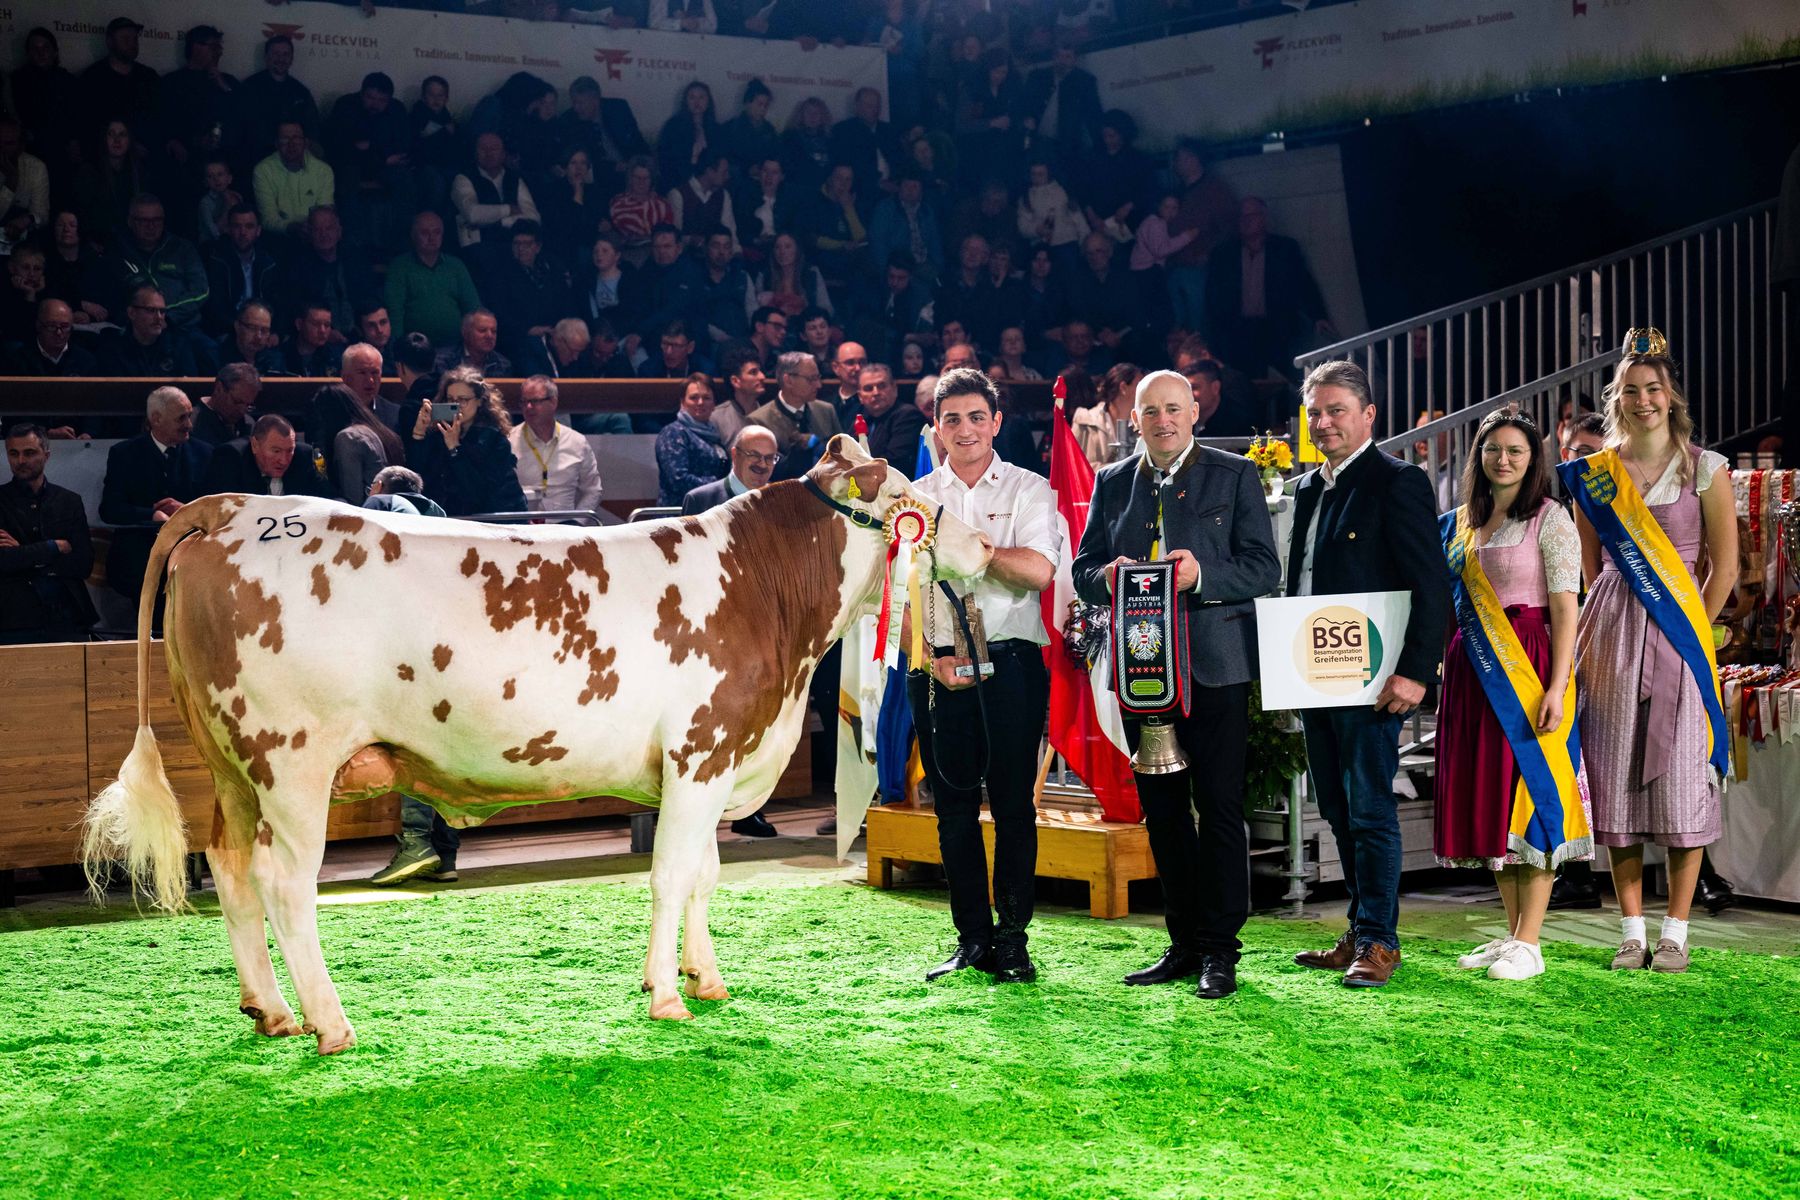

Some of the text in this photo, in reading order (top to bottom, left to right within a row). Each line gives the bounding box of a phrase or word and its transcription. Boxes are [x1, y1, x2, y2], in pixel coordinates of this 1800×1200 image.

[54, 21, 107, 35] Tradition
[311, 33, 378, 48] FLECKVIEH
[257, 514, 307, 541] 25
[1616, 539, 1662, 602] Milchkönigin
[1312, 625, 1362, 649] BSG
[1313, 648, 1363, 656] Besamungsstation
[1314, 655, 1363, 664] Greifenberg
